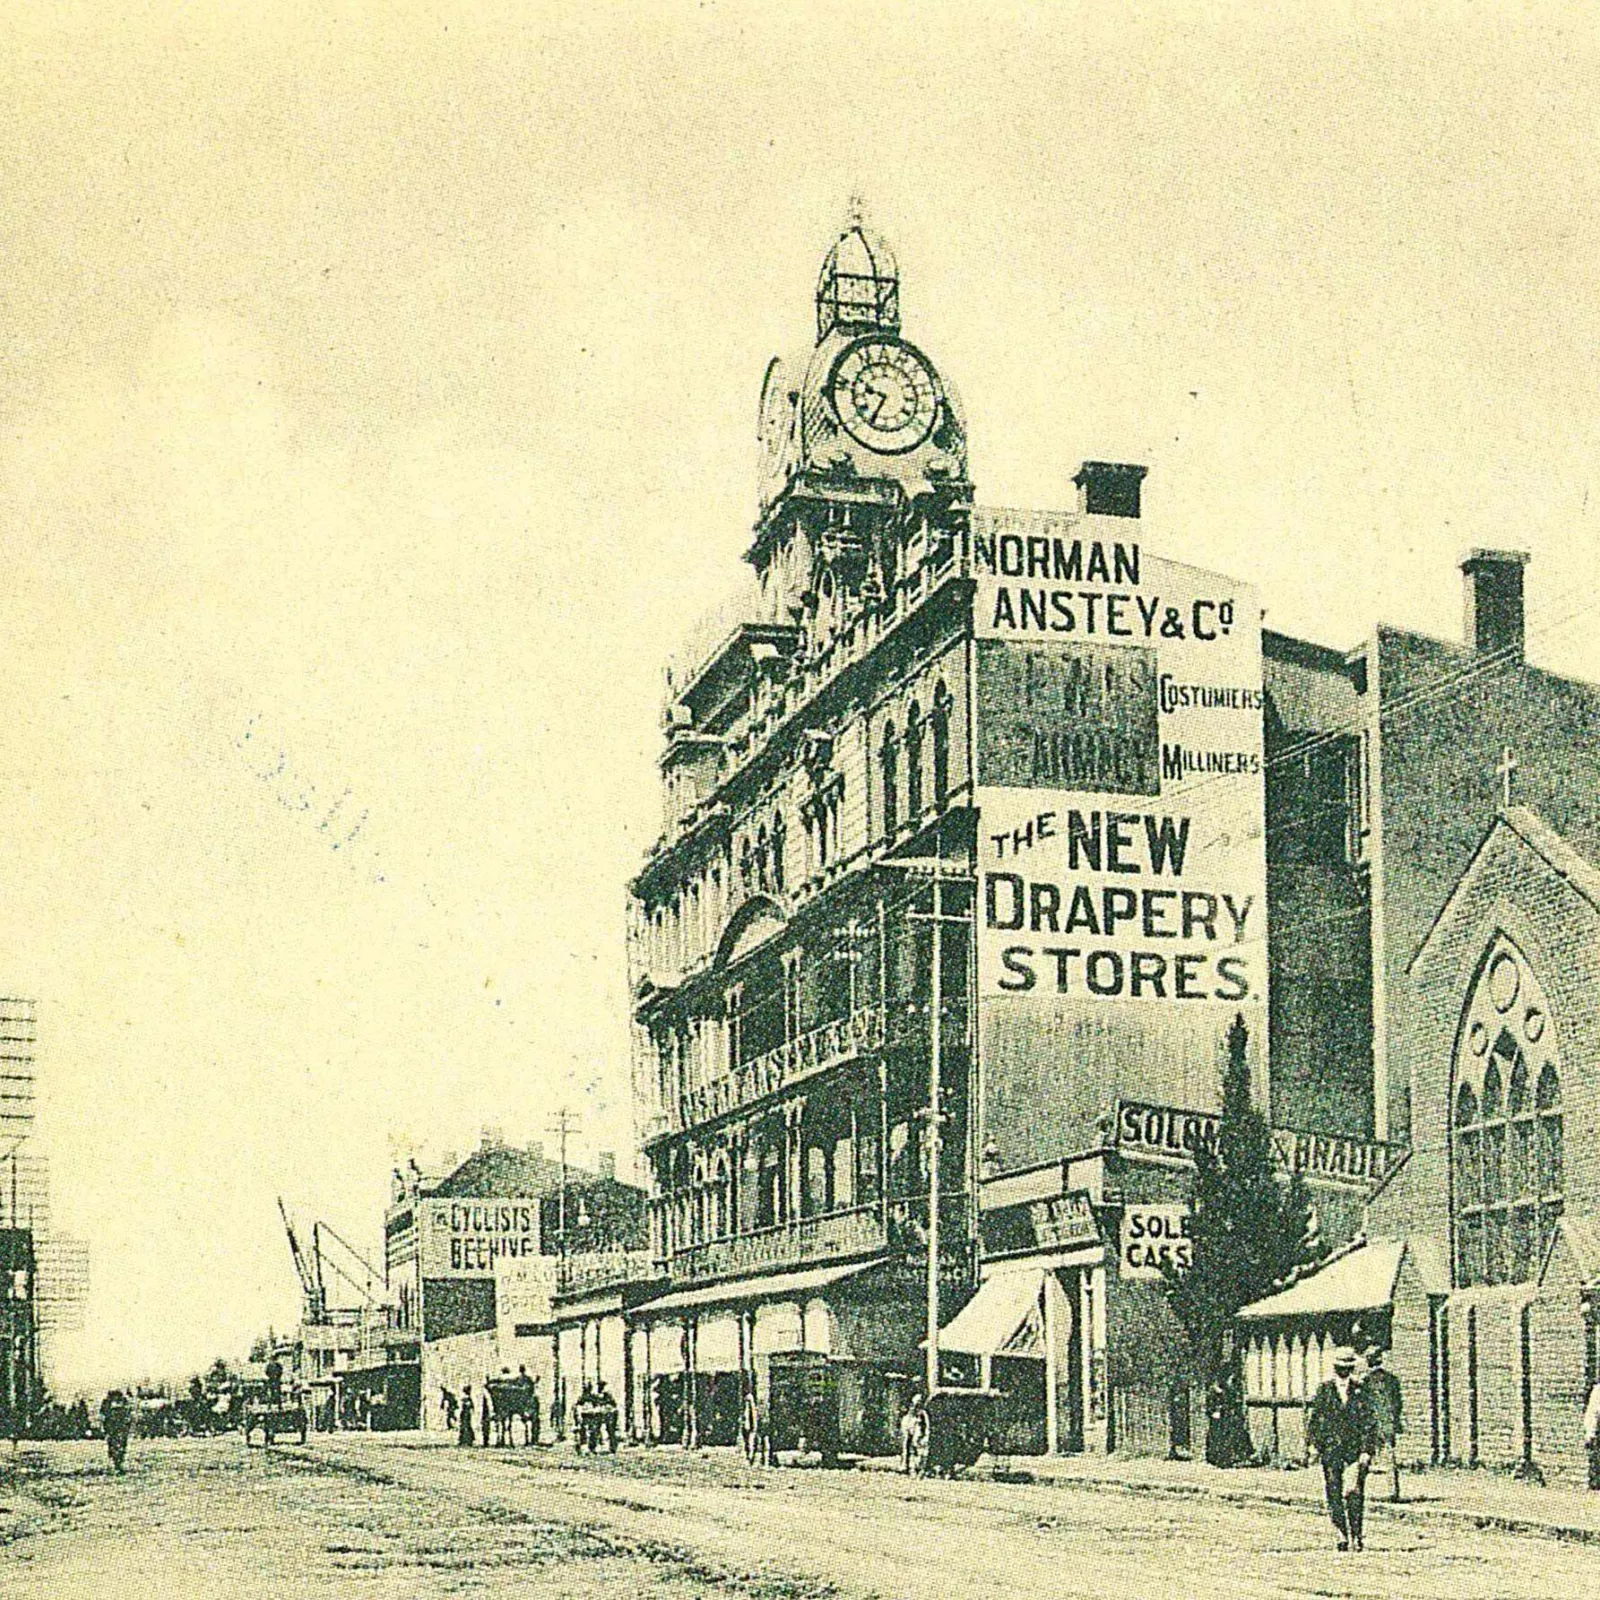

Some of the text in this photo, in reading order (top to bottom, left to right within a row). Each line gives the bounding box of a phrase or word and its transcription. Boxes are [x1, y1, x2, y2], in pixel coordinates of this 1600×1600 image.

[973, 533, 1140, 585] NORMAN
[990, 809, 1191, 876] THE NEW
[984, 872, 1254, 943] DRAPERY
[997, 945, 1260, 1001] STORES.
